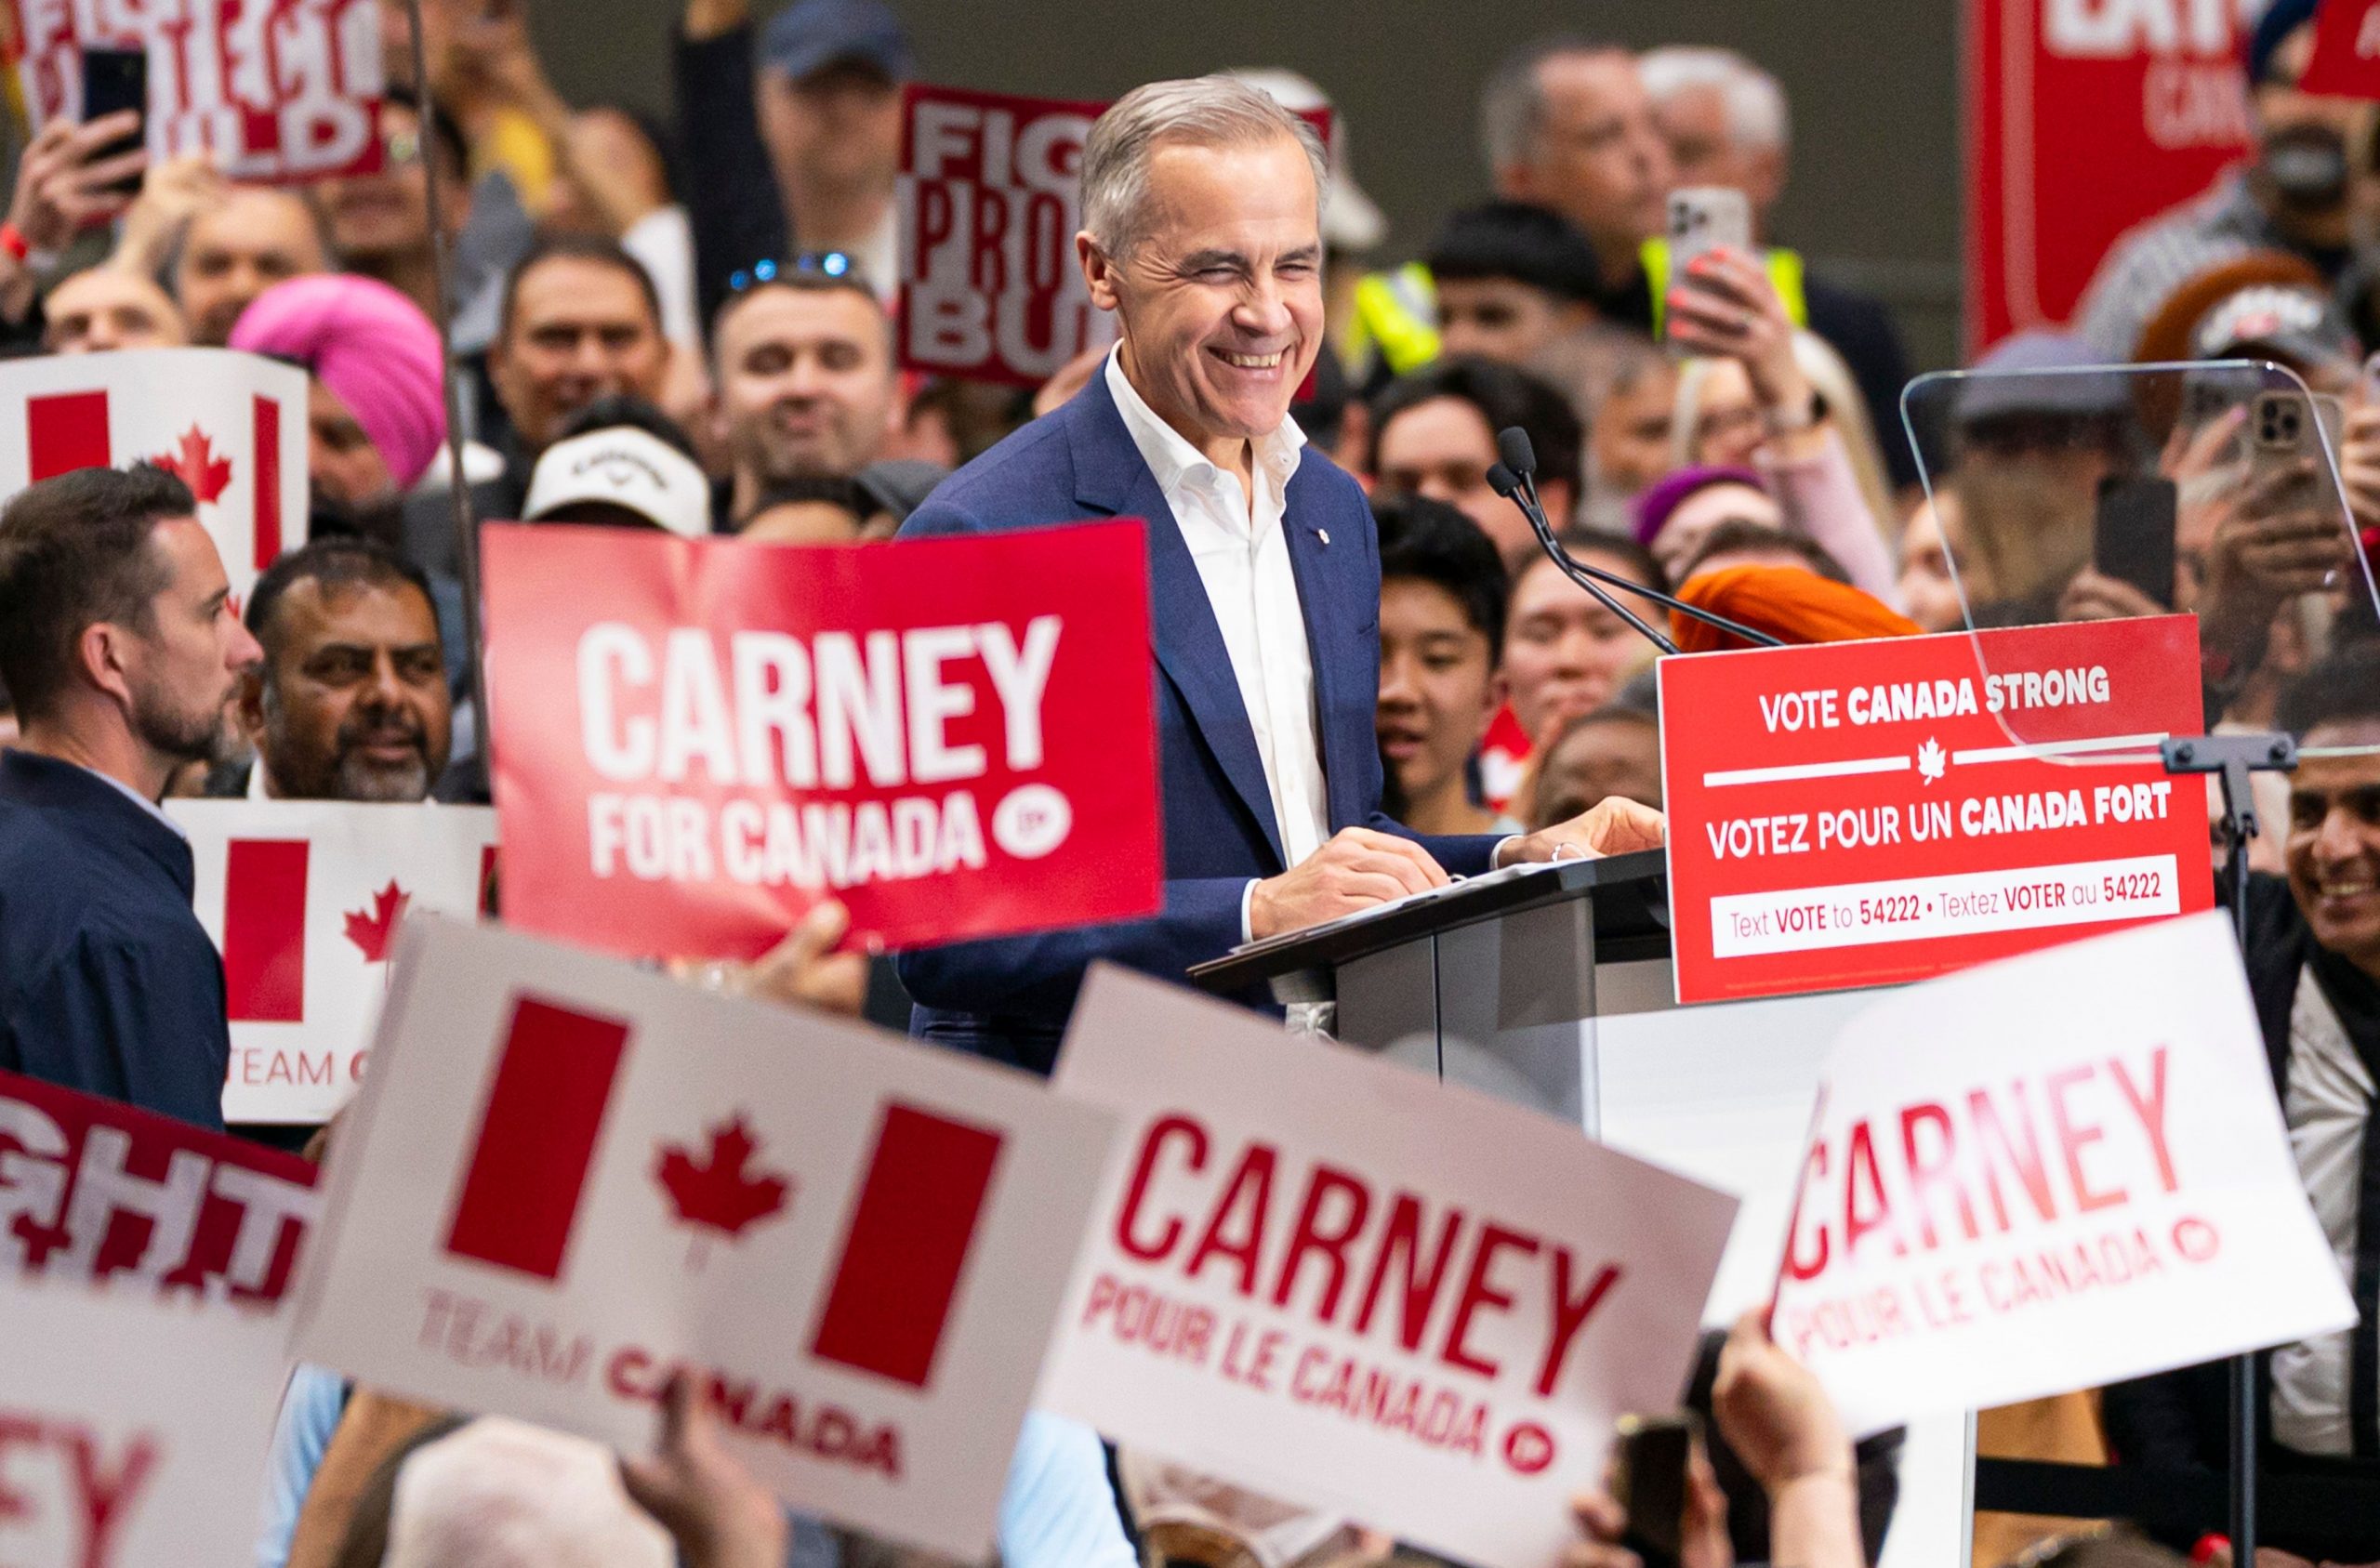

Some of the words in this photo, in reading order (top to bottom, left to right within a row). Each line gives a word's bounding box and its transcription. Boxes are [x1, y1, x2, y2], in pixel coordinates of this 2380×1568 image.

[913, 100, 1090, 188] FIG
[575, 614, 1063, 789] CARNEY
[1759, 689, 1840, 732] VOTE
[1847, 678, 1978, 725] CANADA
[1985, 665, 2110, 714] STRONG
[586, 790, 714, 883] FOR
[718, 789, 987, 889] CANADA
[1706, 813, 1810, 859] VOTEZ
[1818, 806, 1901, 850] POUR
[1909, 800, 1952, 842] UN
[1961, 789, 2087, 837] CANADA
[2094, 781, 2172, 824] FORT
[1731, 910, 1770, 938] Text
[1776, 904, 1826, 933] VOTE
[1832, 903, 1853, 929] to
[1860, 895, 1920, 925] 54222
[1939, 891, 1999, 918] Textez
[2004, 882, 2066, 912] VOTER
[2071, 884, 2097, 905] au
[2103, 872, 2162, 903] 54222
[0, 1095, 324, 1290] GHT
[1780, 1043, 2179, 1281] CARNEY
[1112, 1112, 1625, 1400] CARNEY
[1787, 1285, 1911, 1357] POUR
[1915, 1270, 1974, 1330] LE
[1977, 1225, 2167, 1315] CANADA
[416, 1285, 595, 1384] TEAM
[604, 1343, 906, 1482] CNADA
[1079, 1273, 1216, 1367] POUR
[1219, 1321, 1290, 1391] LE
[1289, 1345, 1492, 1458] CANADA
